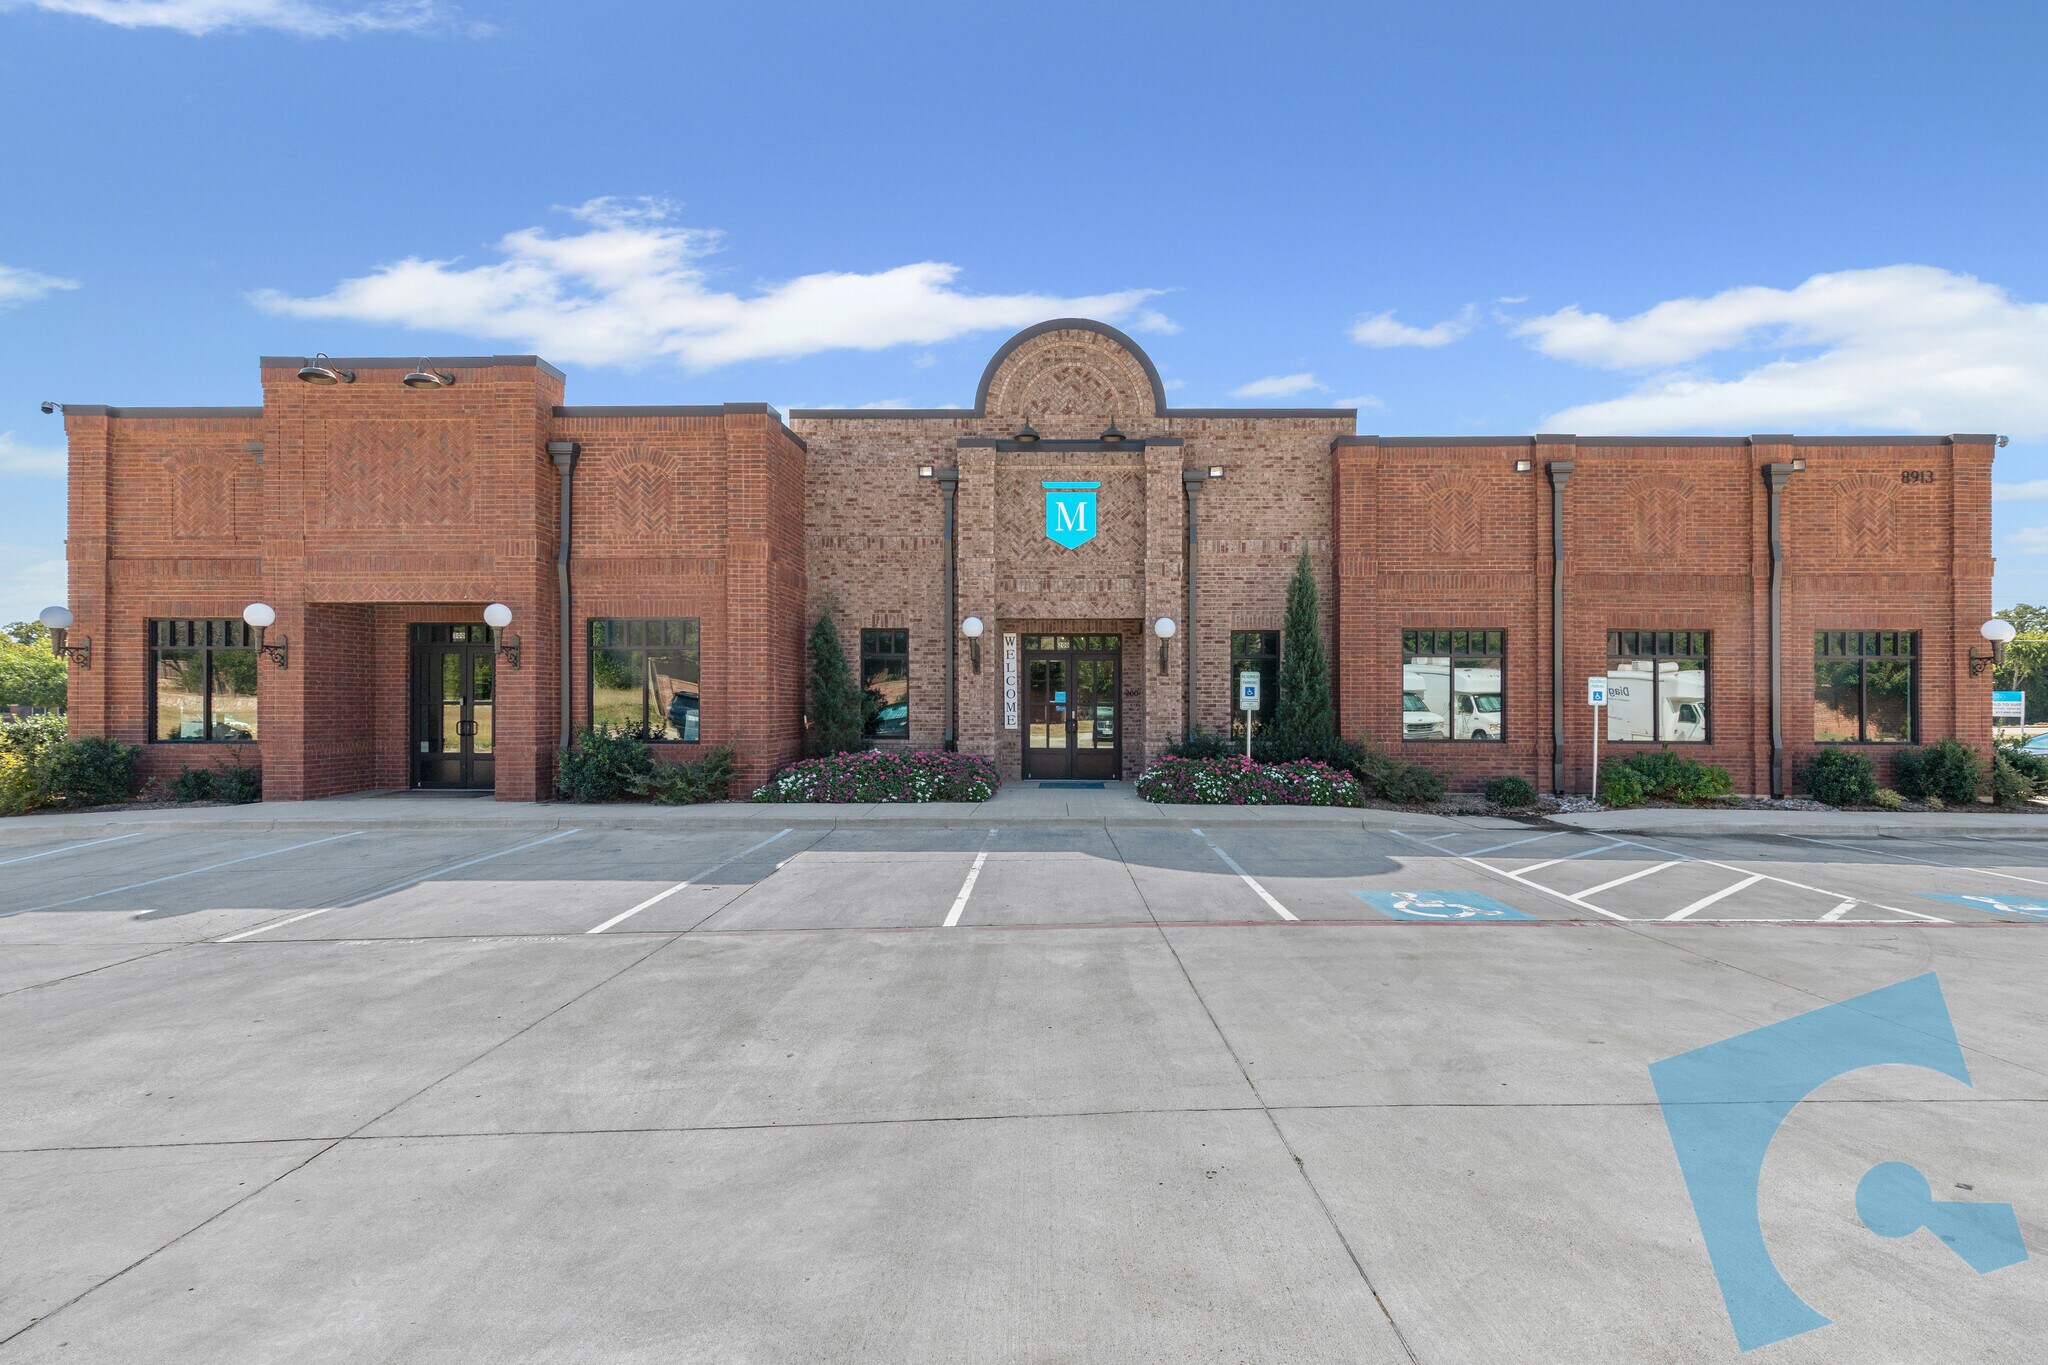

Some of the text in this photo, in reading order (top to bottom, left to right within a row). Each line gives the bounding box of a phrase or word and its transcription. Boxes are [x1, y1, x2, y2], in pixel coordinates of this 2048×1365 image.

[1901, 470, 1934, 484] 8913
[1055, 501, 1088, 532] M
[1005, 636, 1016, 725] WELCOME
